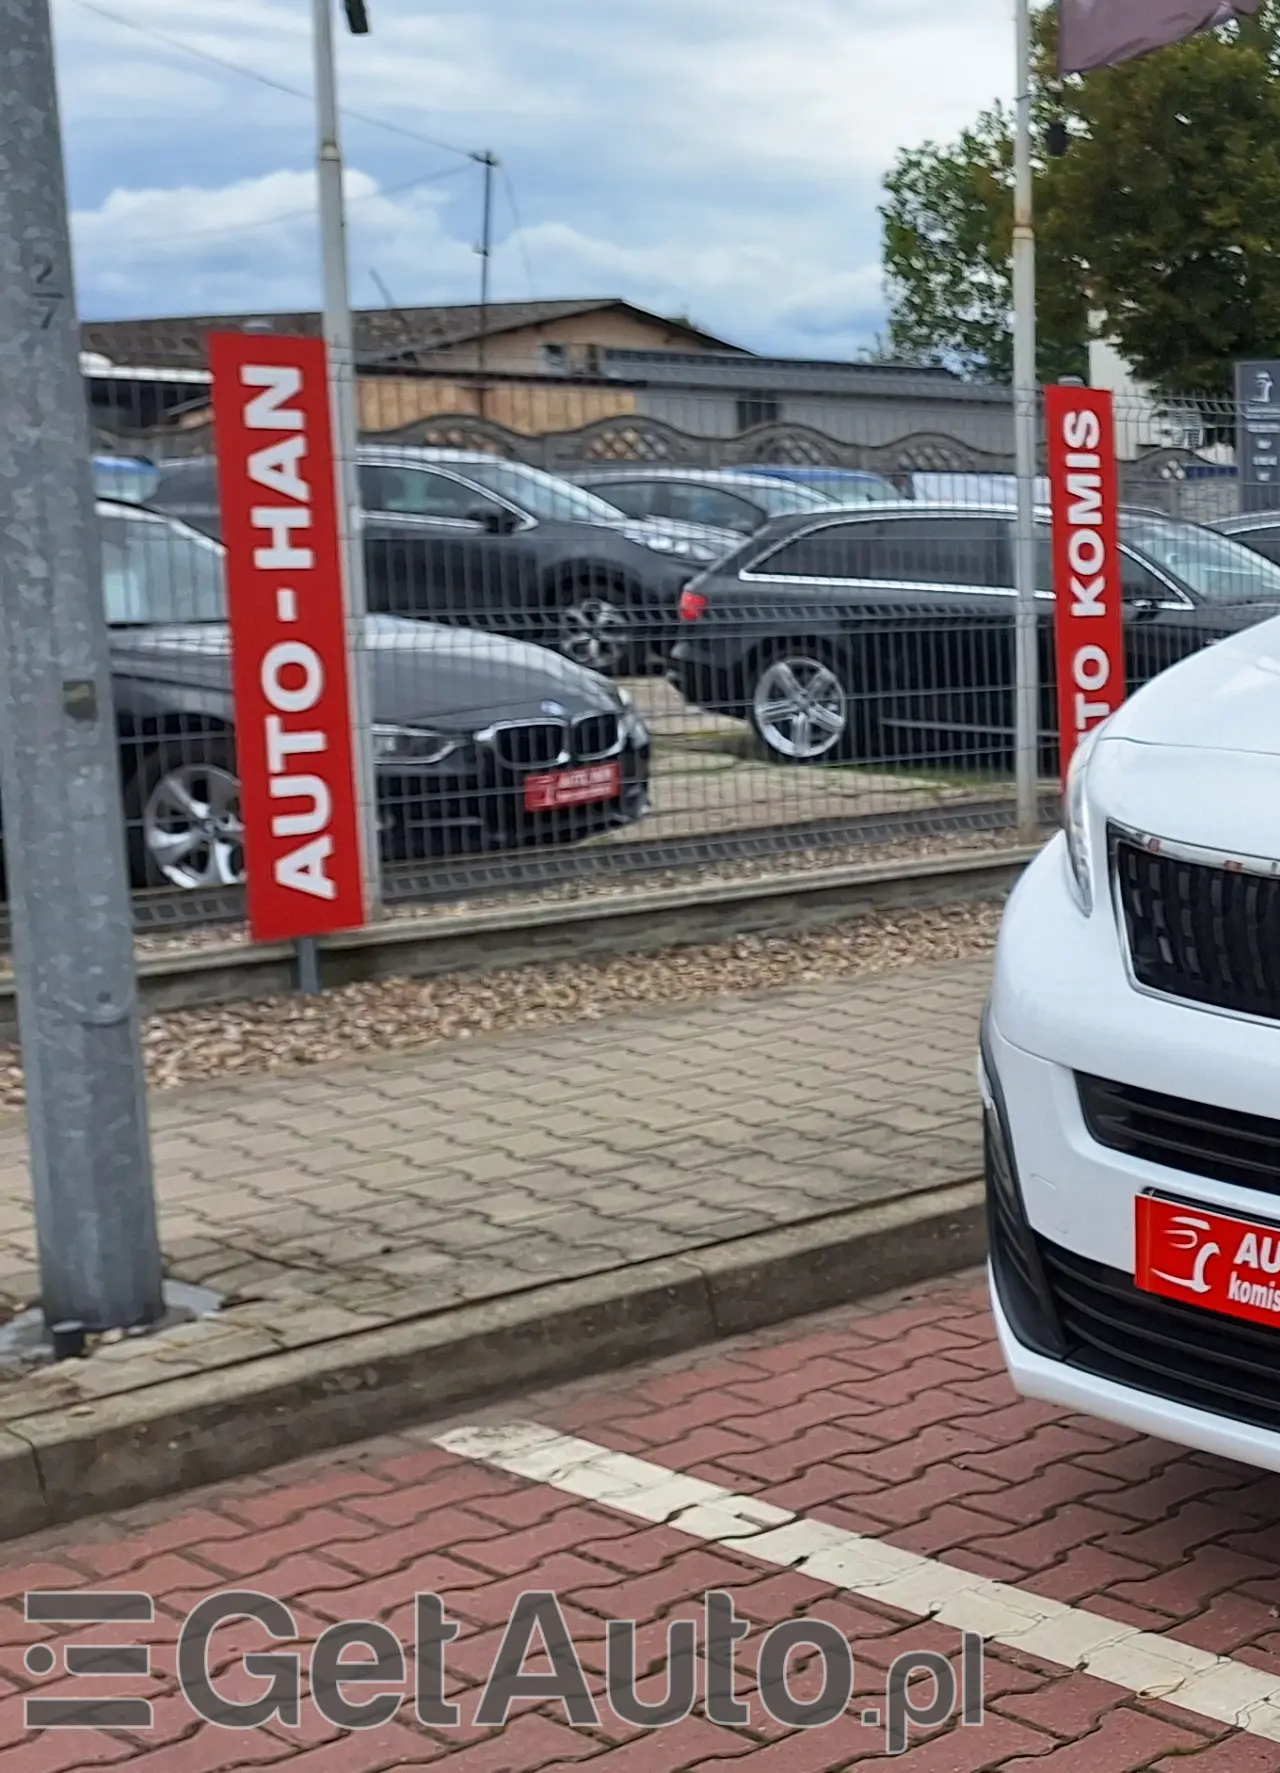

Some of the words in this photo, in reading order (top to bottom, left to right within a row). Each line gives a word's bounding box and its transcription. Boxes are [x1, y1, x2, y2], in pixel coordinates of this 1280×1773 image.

[240, 364, 316, 571] HAN
[1062, 408, 1107, 617] KOMIS
[260, 641, 338, 901] AUTO
[1072, 644, 1111, 746] TO
